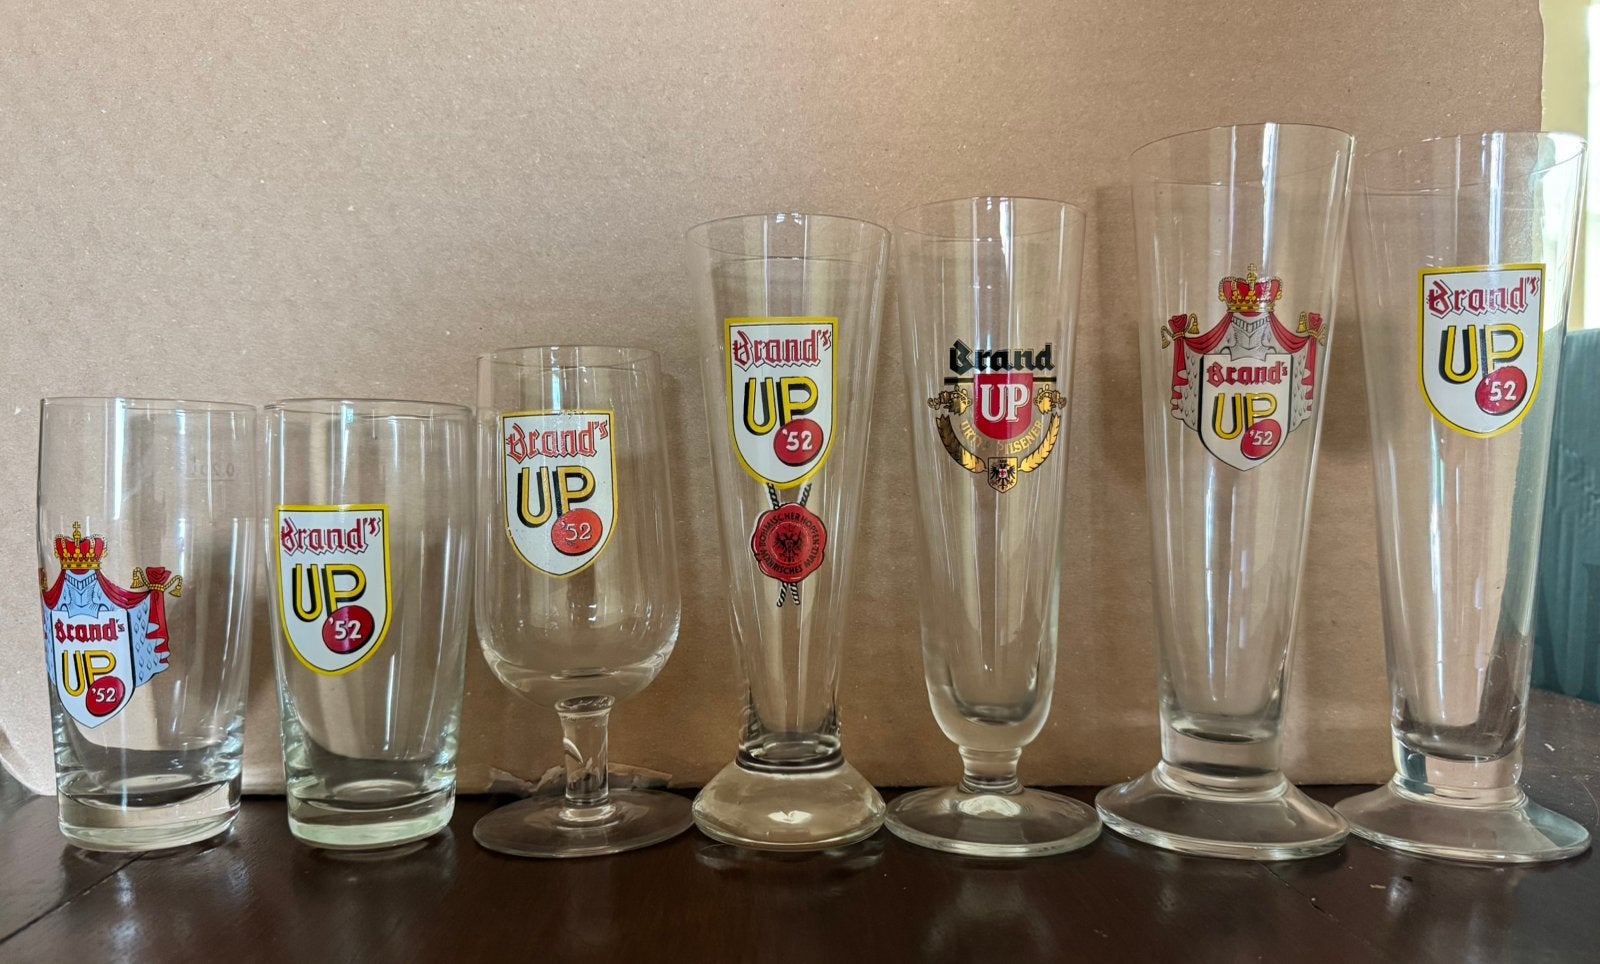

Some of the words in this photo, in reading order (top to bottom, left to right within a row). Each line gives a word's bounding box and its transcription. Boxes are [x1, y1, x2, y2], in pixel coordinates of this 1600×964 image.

[1426, 277, 1540, 319] Brand's
[732, 329, 832, 372] Brand's
[949, 338, 1055, 376] Brand
[1439, 323, 1525, 384] UP
[1206, 361, 1288, 388] Brand's
[1485, 377, 1517, 402] '52
[743, 376, 819, 436] UP
[980, 383, 1030, 422] UP
[1212, 393, 1277, 440] UP
[505, 420, 609, 464] Brand's
[782, 428, 813, 451] '52
[1249, 430, 1273, 446] '52
[517, 465, 596, 528] UP
[281, 517, 382, 556] Brand's
[561, 520, 592, 542] '52
[292, 563, 366, 622] UP
[54, 618, 125, 644] Brand's
[329, 617, 362, 641] '52
[61, 650, 116, 697] UP
[92, 687, 116, 703] '52
